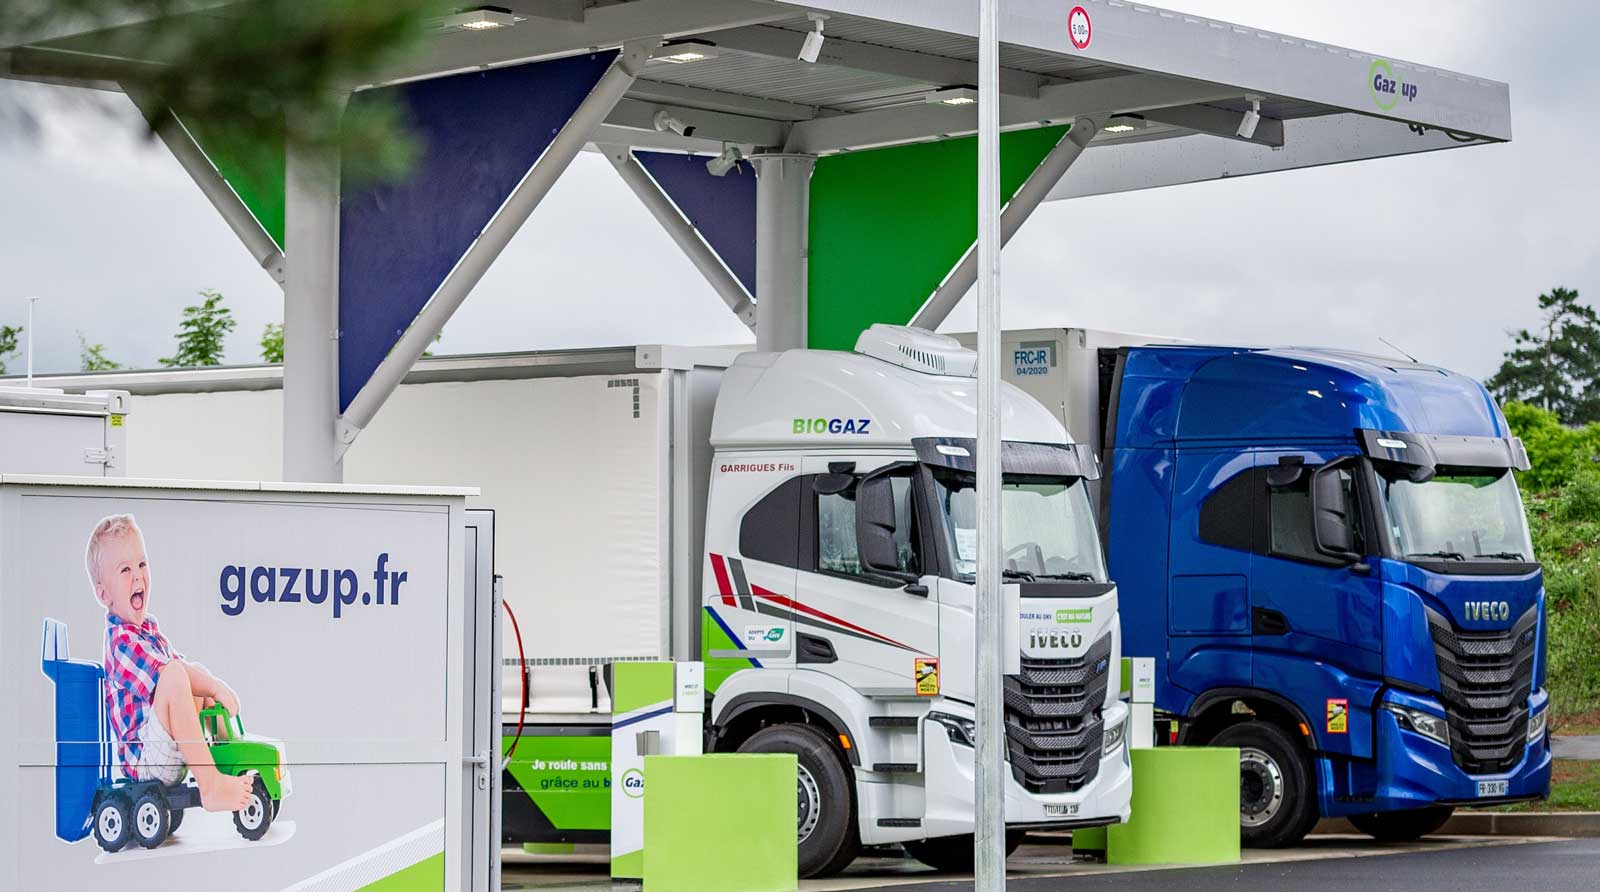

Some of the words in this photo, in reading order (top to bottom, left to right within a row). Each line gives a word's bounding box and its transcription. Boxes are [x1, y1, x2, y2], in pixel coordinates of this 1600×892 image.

[1014, 350, 1047, 365] FRC-IR
[1016, 366, 1048, 375] 04/2020
[792, 418, 871, 434] BIOGAZ
[720, 463, 776, 473] GARRIGUES
[778, 463, 795, 472] Fils
[219, 552, 408, 619] gazup.fr
[1464, 601, 1510, 621] IVECO
[1030, 628, 1082, 649] IVECO
[531, 759, 546, 770] Je
[548, 759, 578, 770] roule
[580, 761, 608, 771] sans
[540, 776, 579, 790] grâce
[582, 779, 600, 788] au
